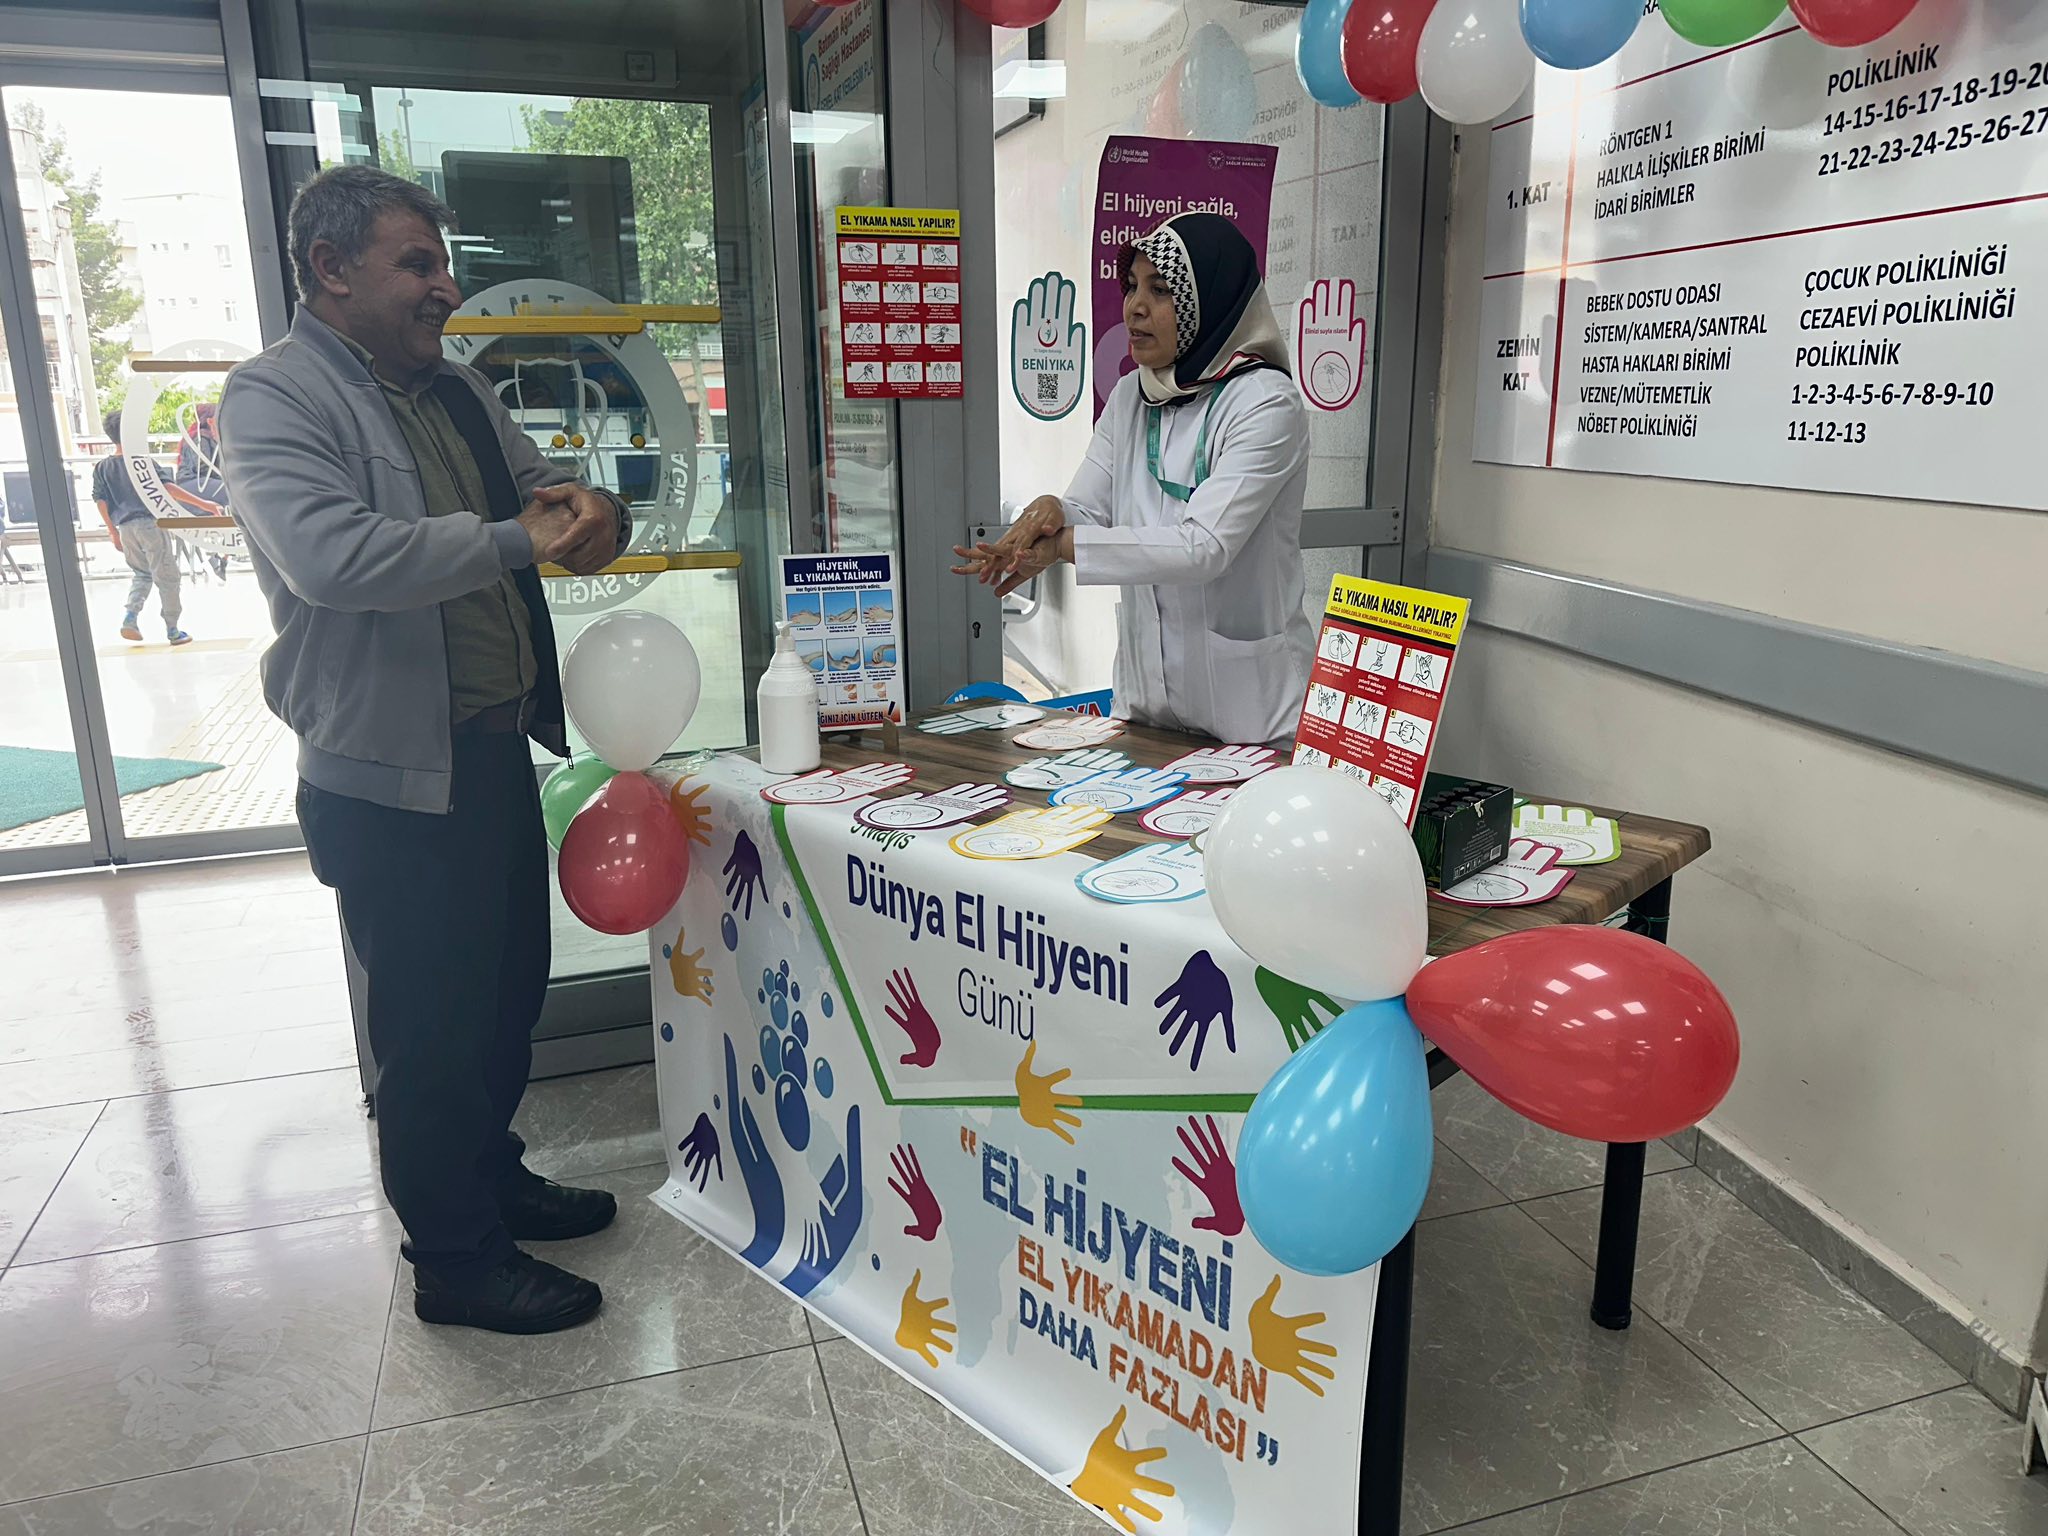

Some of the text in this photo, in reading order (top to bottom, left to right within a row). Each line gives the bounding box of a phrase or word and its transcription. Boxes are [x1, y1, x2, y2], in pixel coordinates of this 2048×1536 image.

[1827, 43, 1941, 97] POLİKLİNİK
[1599, 119, 1673, 157] RÖNTGEN 1
[1596, 126, 1767, 189] HALKLA İLİŞKİLER BİRİMİ
[1102, 192, 1238, 219] El hijyeni sağla,
[1506, 181, 1551, 209] 1. KAT
[1594, 182, 1696, 221] İDARİ BİRİMLER
[840, 215, 955, 228] EL YIKAMA NASIL YAPILIR?
[1804, 244, 2008, 298] ÇOCUK POLİKLİNİĞİ
[1586, 282, 1721, 314] BEBEK DOSTU ODASI
[1800, 287, 2016, 331] CEZAEVİ POLİKLİNİĞİ
[1583, 312, 1768, 344] SİSTEM/KAMERA/SANTRAL
[1496, 336, 1540, 359] ZEMİN
[1581, 346, 1731, 374] HASTA HAKLARI BİRİMİ
[1795, 340, 1901, 369] POLİKLİNİK
[1022, 356, 1074, 371] BENİ YIKA
[1502, 371, 1529, 392] KAT
[1579, 382, 1712, 406] VEZNE/MÜTEMETLİK
[1791, 381, 1994, 407] 1-2-3-4-5-6-7-8-9-10
[1577, 413, 1697, 438] NÖBET POLİKLİNİĞİ
[1787, 420, 1867, 444] 11-12-13
[794, 569, 882, 582] EL YIKAMA TALİMATI
[816, 559, 858, 571] HİJYENİK
[1332, 587, 1457, 629] EL YIKAMA NASIL YAPILIR?
[840, 711, 856, 723] İÇİN
[858, 710, 883, 722] LÜTFEN
[846, 853, 1129, 1006] Dünya El Hijyeni
[957, 967, 1035, 1042] Günü
[1044, 1168, 1234, 1332] HİJYENİ
[1018, 1234, 1269, 1413] EL YIKAMADAN
[1019, 1287, 1099, 1370] DAHA
